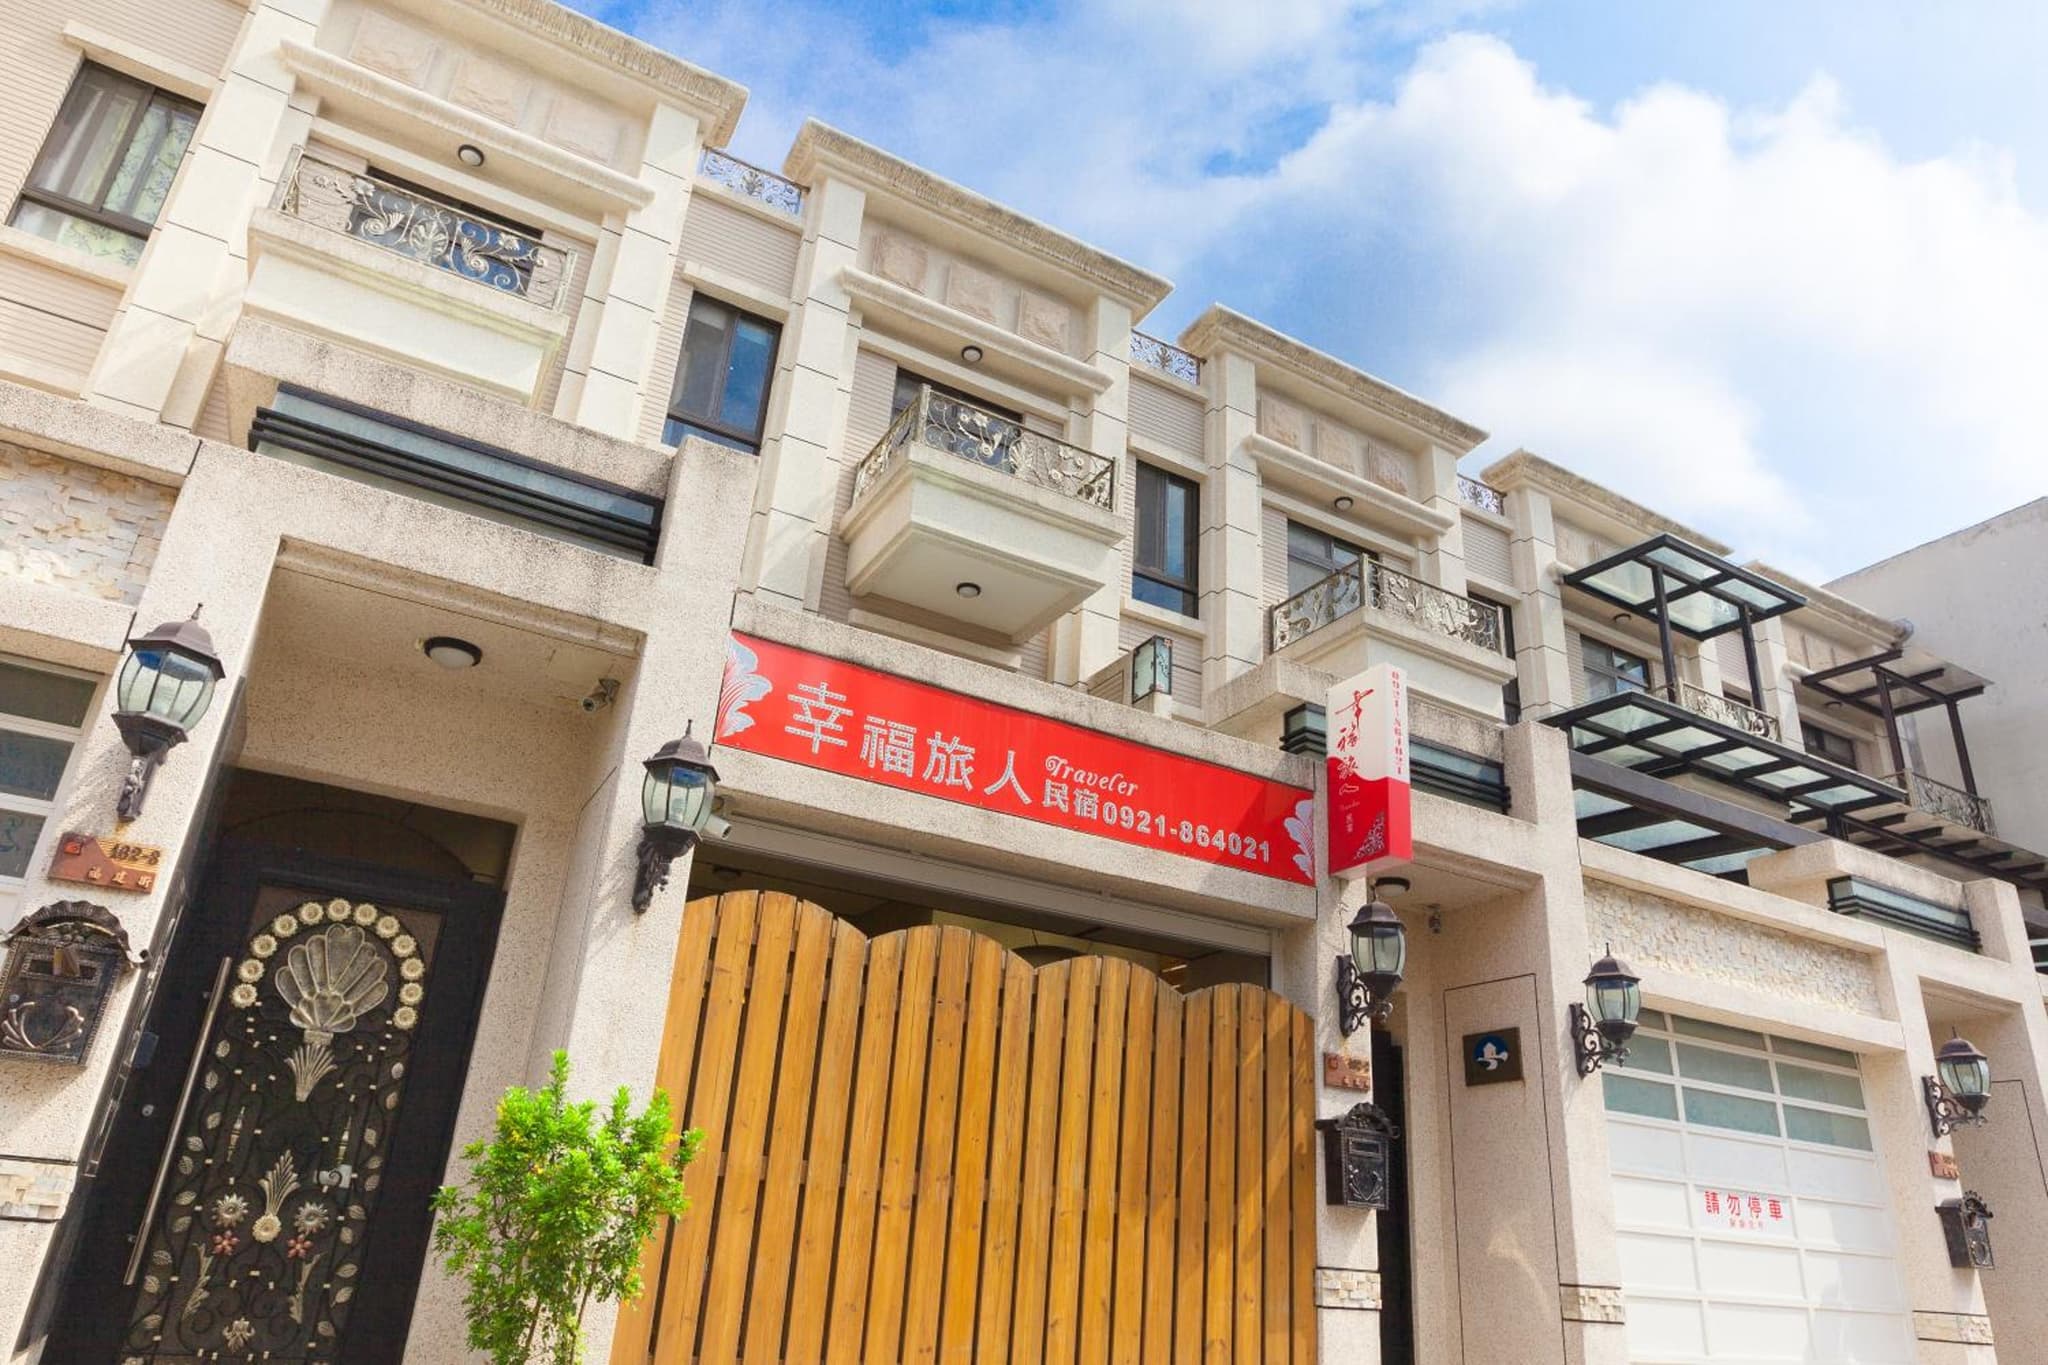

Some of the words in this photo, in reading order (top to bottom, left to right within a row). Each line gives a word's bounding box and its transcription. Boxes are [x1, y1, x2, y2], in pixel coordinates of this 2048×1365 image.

[784, 681, 1033, 805] 幸福旅人
[1045, 755, 1139, 797] Traveler
[1042, 779, 1099, 820] 民宿
[1102, 801, 1271, 864] 0921-864021
[1704, 1190, 1784, 1221] 請勿停車
